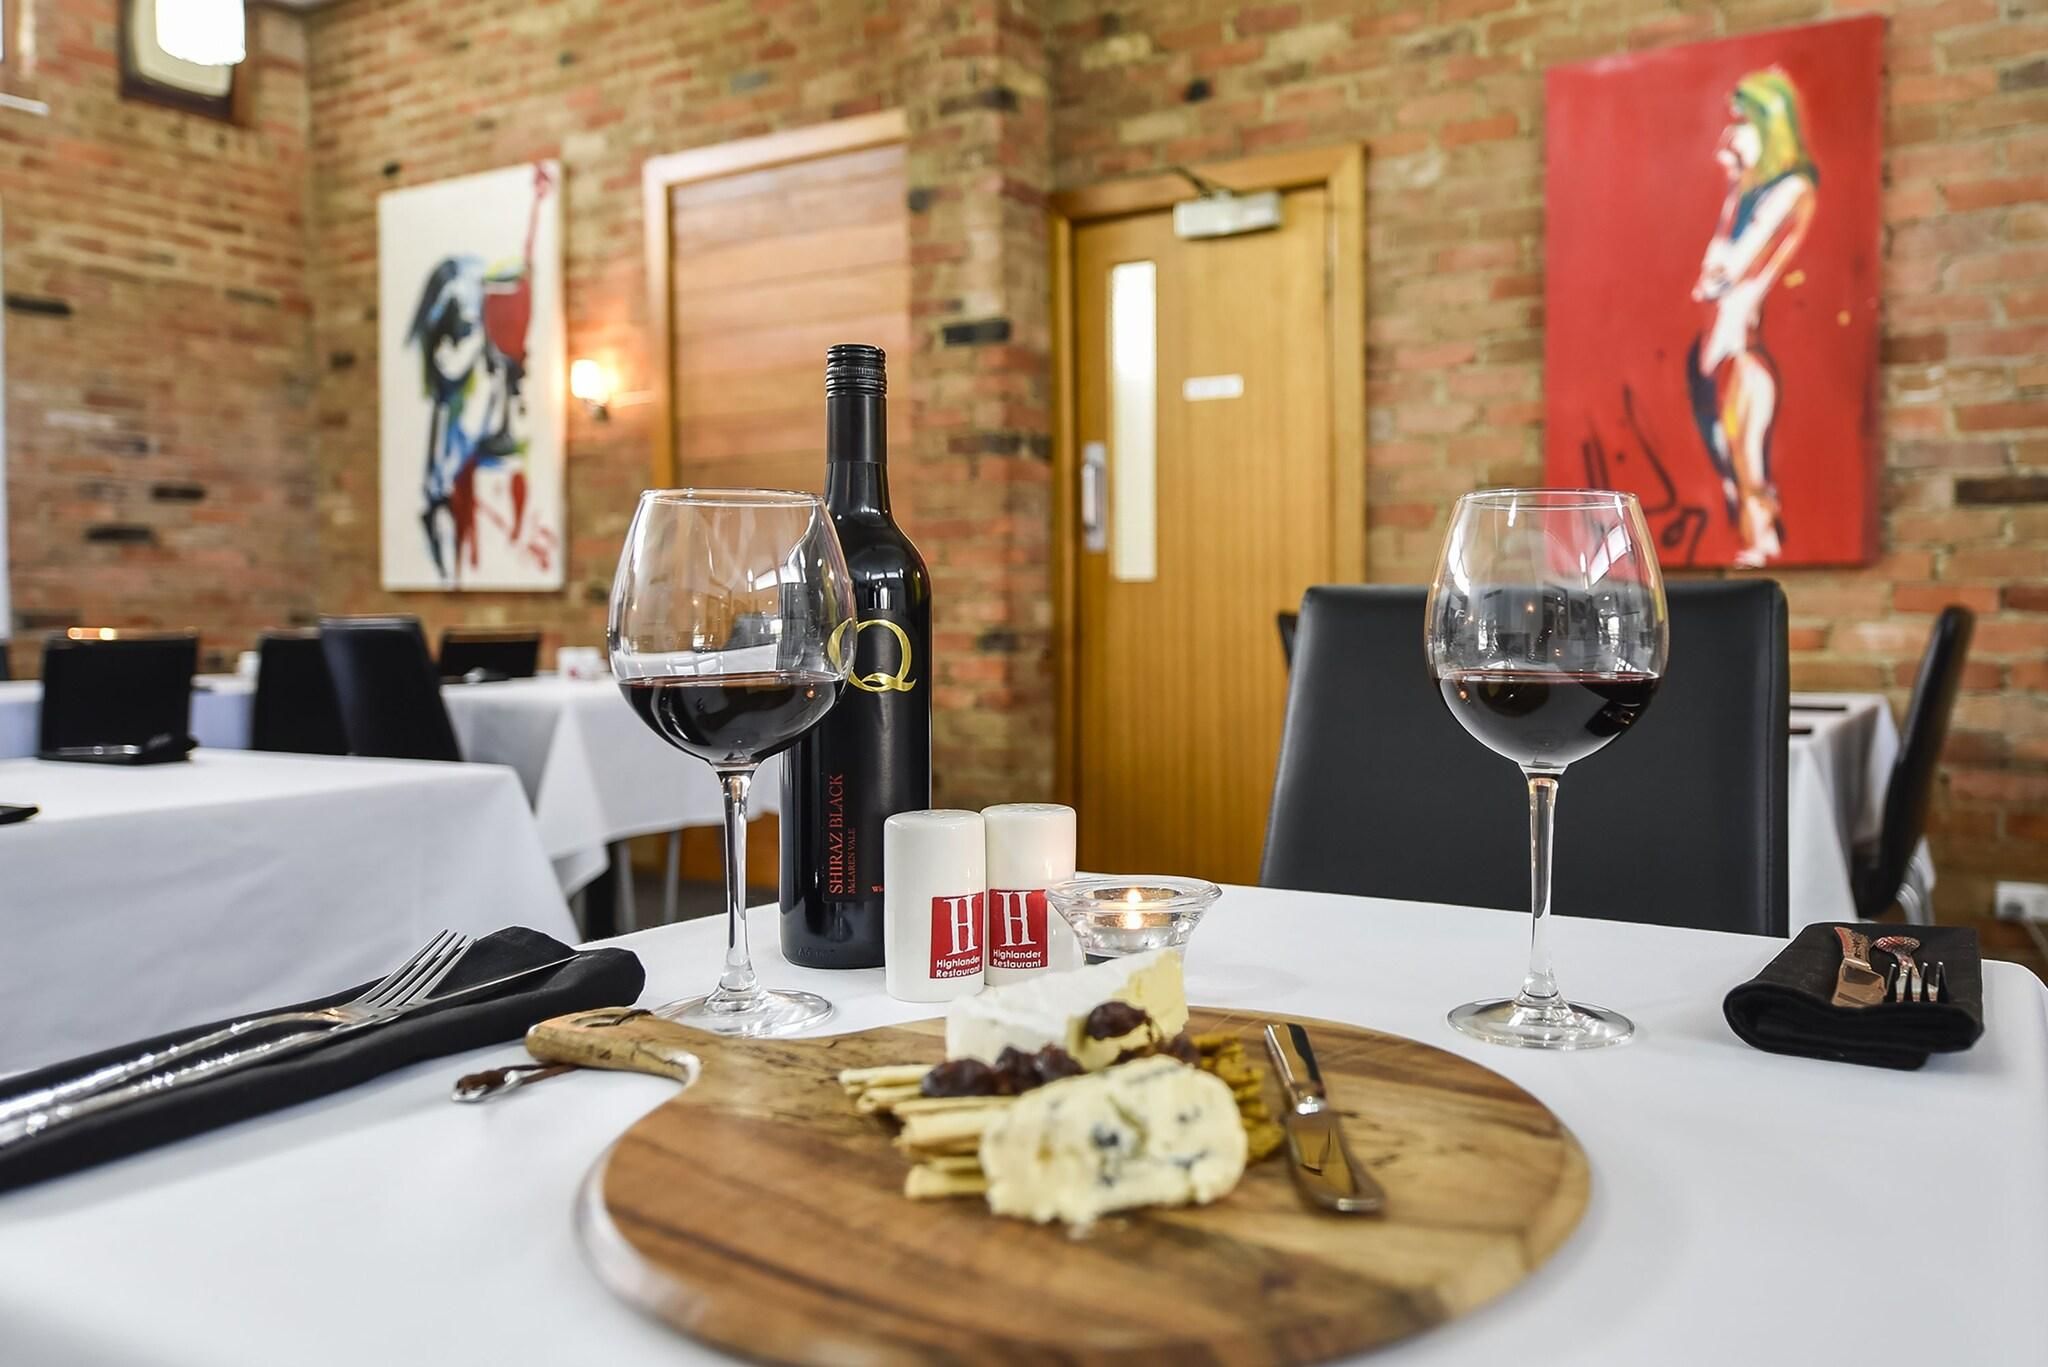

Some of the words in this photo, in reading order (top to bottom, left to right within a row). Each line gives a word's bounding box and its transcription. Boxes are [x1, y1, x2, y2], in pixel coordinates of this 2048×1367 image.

[827, 617, 917, 692] Q
[829, 774, 843, 827] BLACK
[847, 827, 857, 851] VALE
[829, 833, 843, 894] SHIRAZ
[943, 894, 978, 957] H
[997, 891, 1037, 947] H
[936, 955, 980, 970] Highlander
[936, 964, 980, 978] Restaurant
[993, 949, 1041, 960] Highlander
[993, 959, 1041, 969] Restaurant
